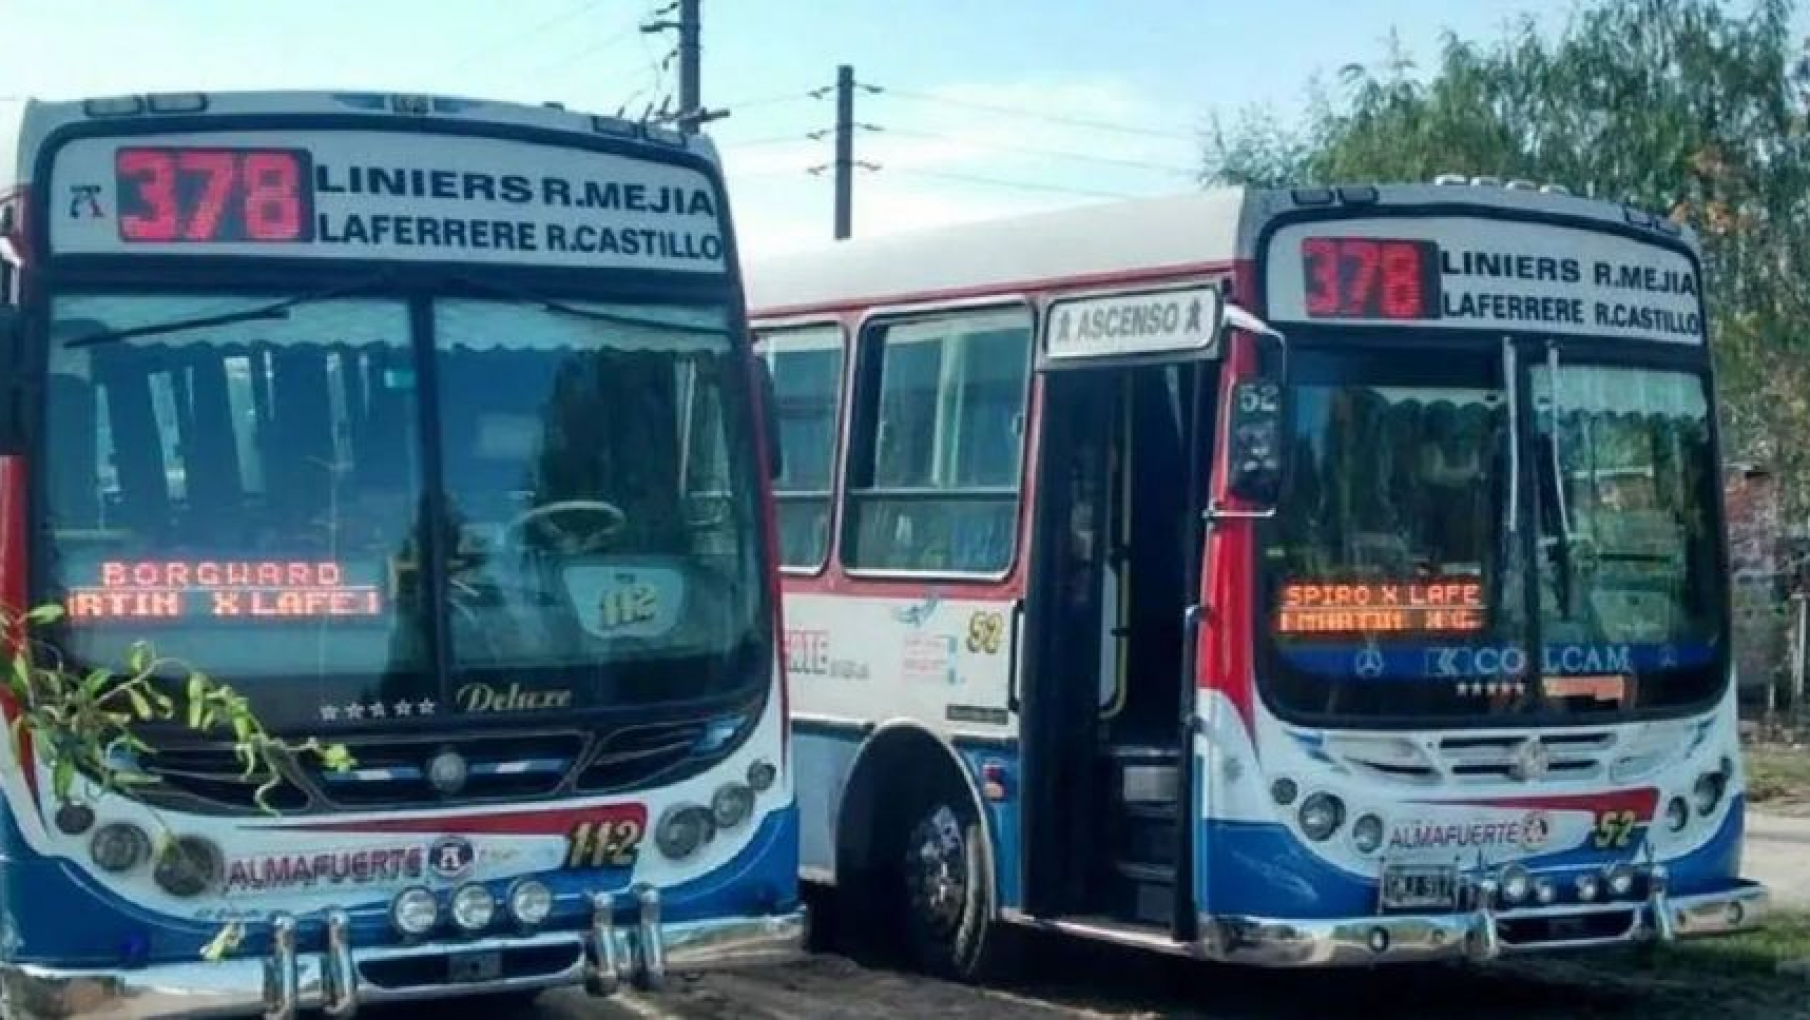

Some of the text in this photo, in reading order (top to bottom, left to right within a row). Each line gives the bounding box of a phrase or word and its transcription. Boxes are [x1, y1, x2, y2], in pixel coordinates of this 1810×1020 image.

[116, 149, 301, 241] 378
[315, 164, 718, 219] LINIERS R.MEJIA
[317, 212, 723, 261] LAFERRERE R.CASTILLO
[1302, 238, 1424, 318] 378
[1440, 250, 1697, 296] LINIERS R.MEJIA
[1077, 302, 1180, 339] ASCENSO
[1443, 292, 1700, 335] LAFERRERE R.CASTILLO
[1236, 383, 1280, 412] 52
[102, 561, 340, 585] BORGWARD
[1286, 585, 1482, 604] SPIRO X LAFE
[966, 609, 1004, 654] 52
[456, 681, 573, 712] Deluxe
[566, 819, 641, 868] 112
[1389, 822, 1519, 849] ALMAFUERTE
[1594, 809, 1636, 849] 52
[228, 844, 424, 890] ALMAFUERTE
